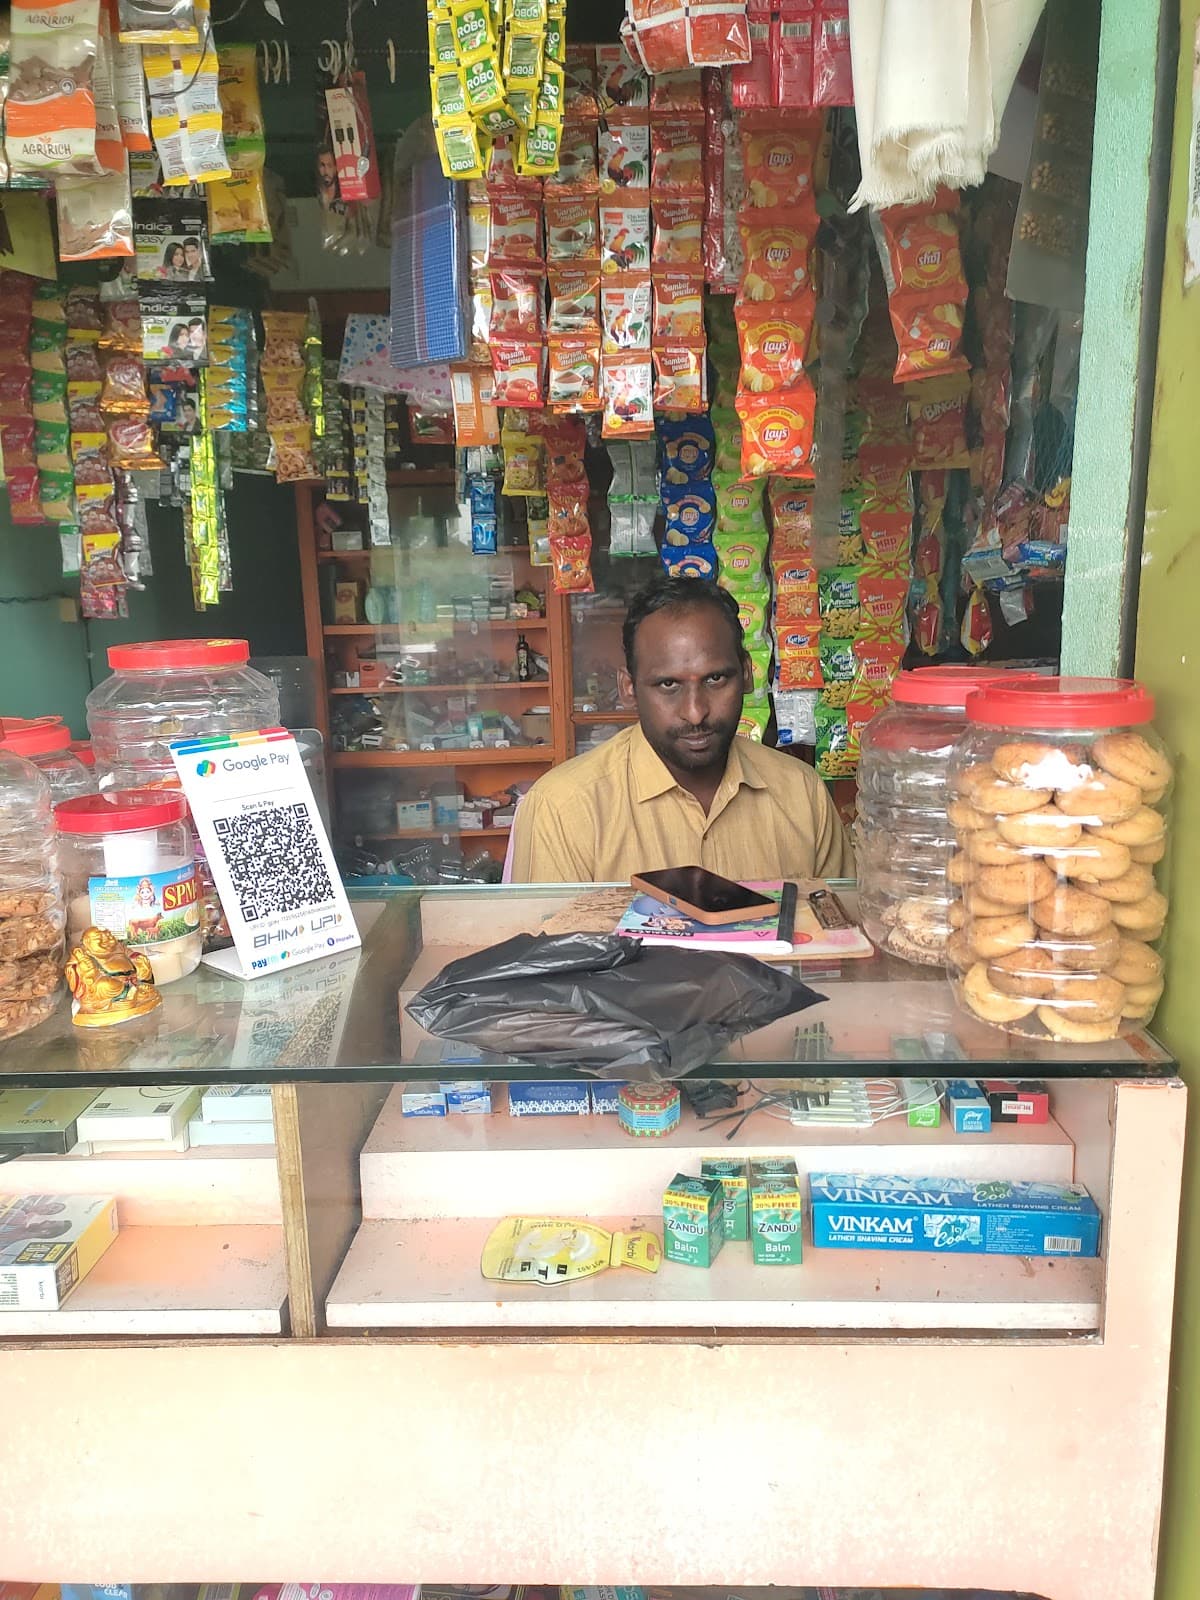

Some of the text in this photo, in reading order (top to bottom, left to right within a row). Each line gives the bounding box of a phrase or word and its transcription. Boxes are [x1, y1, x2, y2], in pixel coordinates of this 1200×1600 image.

[514, 8, 538, 17] ROBO
[24, 14, 75, 28] AGRIRICH
[457, 19, 485, 37] ROBO
[511, 65, 534, 75] ROBO
[467, 70, 494, 91] ROBO
[442, 101, 465, 113] ROBO
[527, 138, 556, 151] ROBO
[22, 143, 72, 159] AGRIRICH
[451, 159, 475, 172] ROBO
[134, 222, 173, 232] Indica
[140, 303, 178, 313] Indica
[500, 350, 524, 361] Rasam
[557, 350, 582, 361] Garam
[876, 539, 897, 549] MAD
[872, 602, 893, 612] MAD
[866, 666, 887, 675] MAD
[222, 752, 289, 771] Google Pay
[164, 879, 197, 909] SPM
[253, 926, 298, 948] BHIM
[311, 913, 337, 931] UPI
[292, 945, 314, 957] Google
[821, 1187, 953, 1206] VINKAM
[972, 1189, 1013, 1203] Cool
[680, 1200, 705, 1212] FREE
[668, 1219, 704, 1236] ZANDU
[758, 1222, 797, 1233] ZANDU
[828, 1215, 914, 1233] VINKAM
[828, 1234, 914, 1244] LATHER SHAVING CREAM
[934, 1231, 968, 1248] Cool
[674, 1240, 699, 1254] Balm
[765, 1243, 791, 1253] Balm
[104, 1588, 128, 1598] CLEAR
